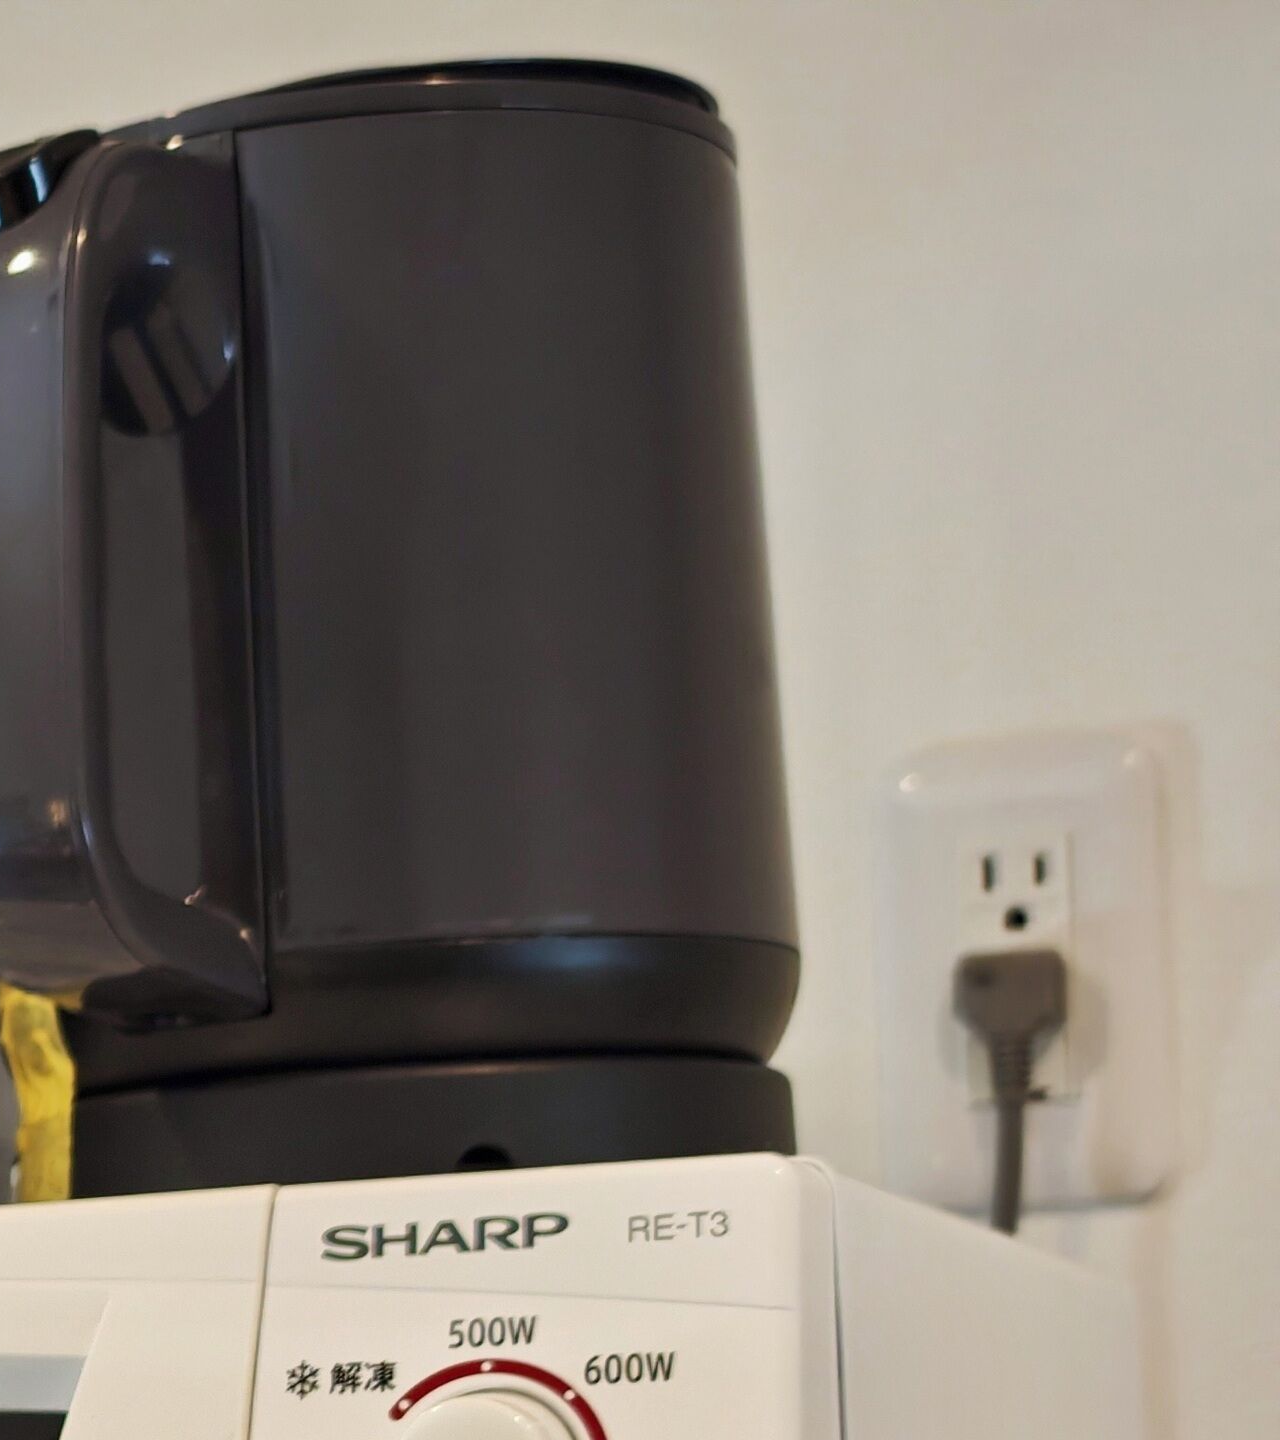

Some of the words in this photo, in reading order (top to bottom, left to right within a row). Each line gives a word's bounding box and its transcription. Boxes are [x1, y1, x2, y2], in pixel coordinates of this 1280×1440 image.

[320, 1212, 569, 1262] SHARP
[627, 1210, 730, 1243] RE-T3
[448, 1315, 538, 1349] 500W
[329, 1360, 398, 1394] 解凍
[583, 1351, 676, 1385] 600W
